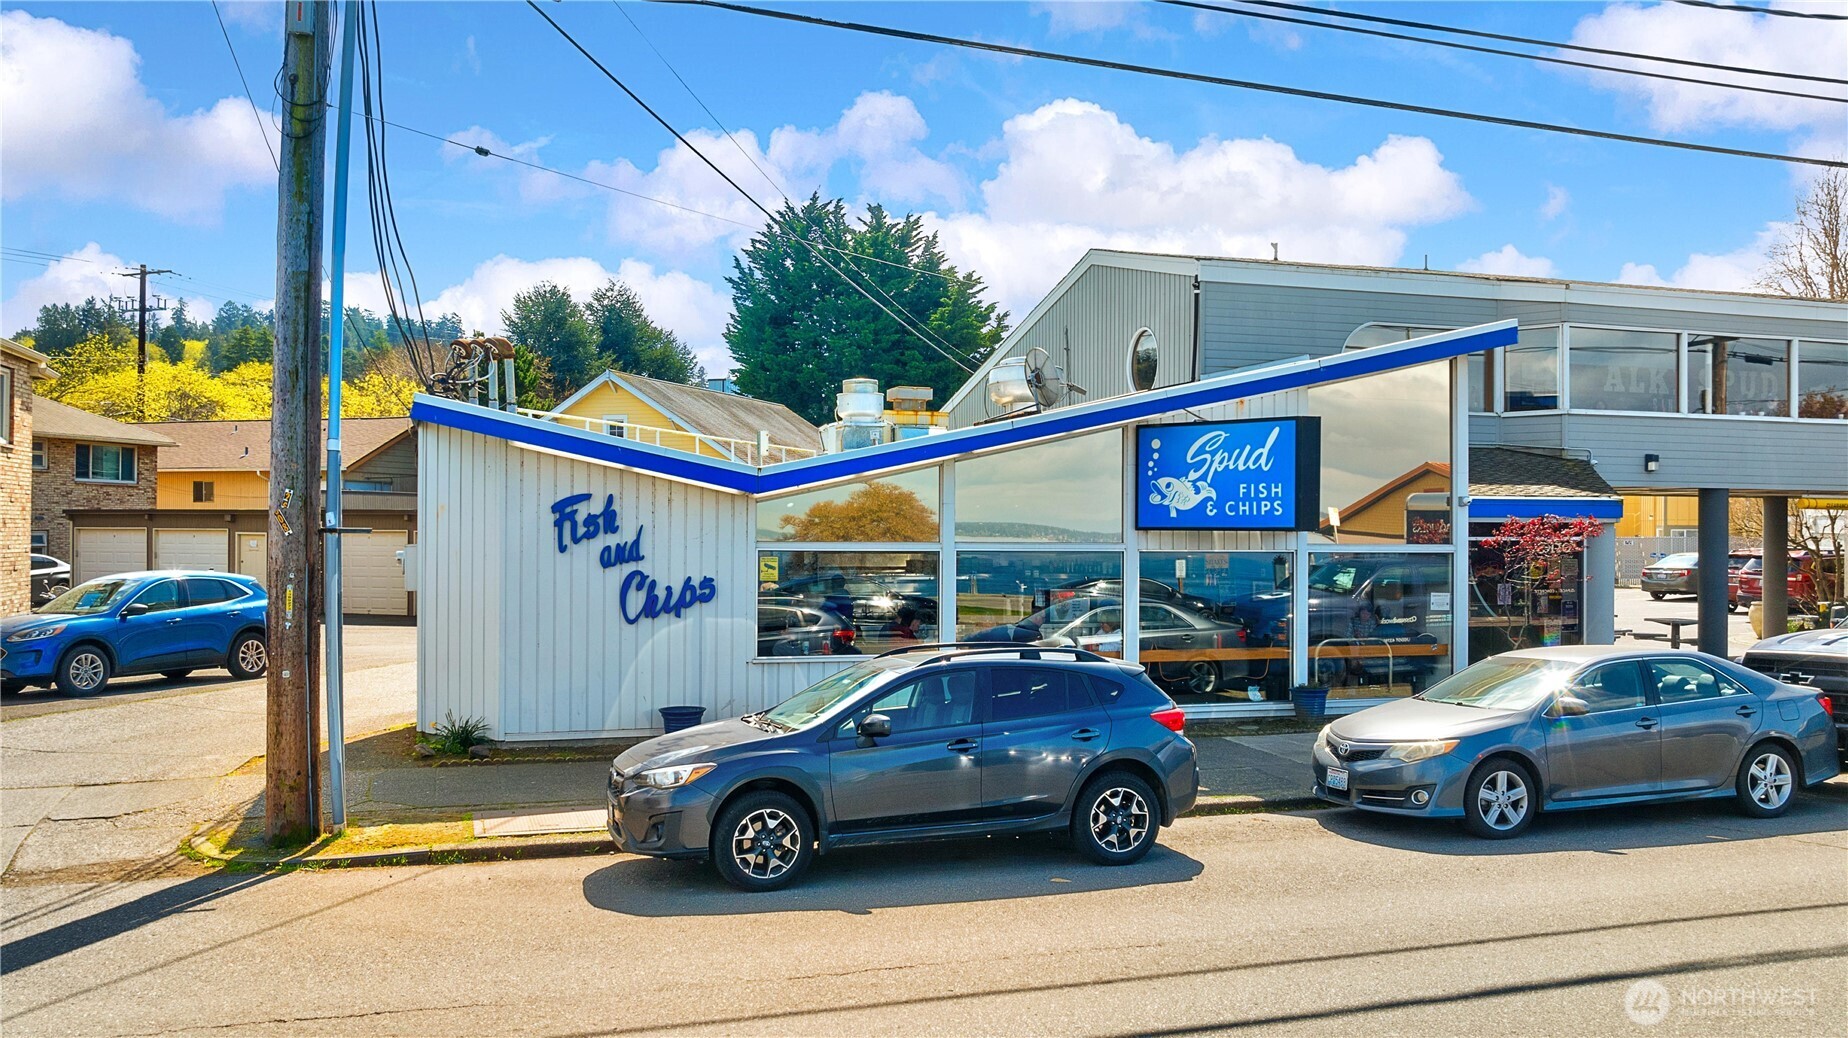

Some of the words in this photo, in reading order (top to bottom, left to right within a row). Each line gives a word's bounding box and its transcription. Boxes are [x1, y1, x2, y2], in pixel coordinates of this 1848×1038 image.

[1186, 426, 1280, 484] Spud
[1206, 501, 1217, 516] &
[1225, 501, 1283, 516] CHIPS
[1239, 483, 1282, 498] FISH
[551, 493, 619, 553] Fish
[600, 524, 645, 569] and
[620, 569, 716, 625] Chips
